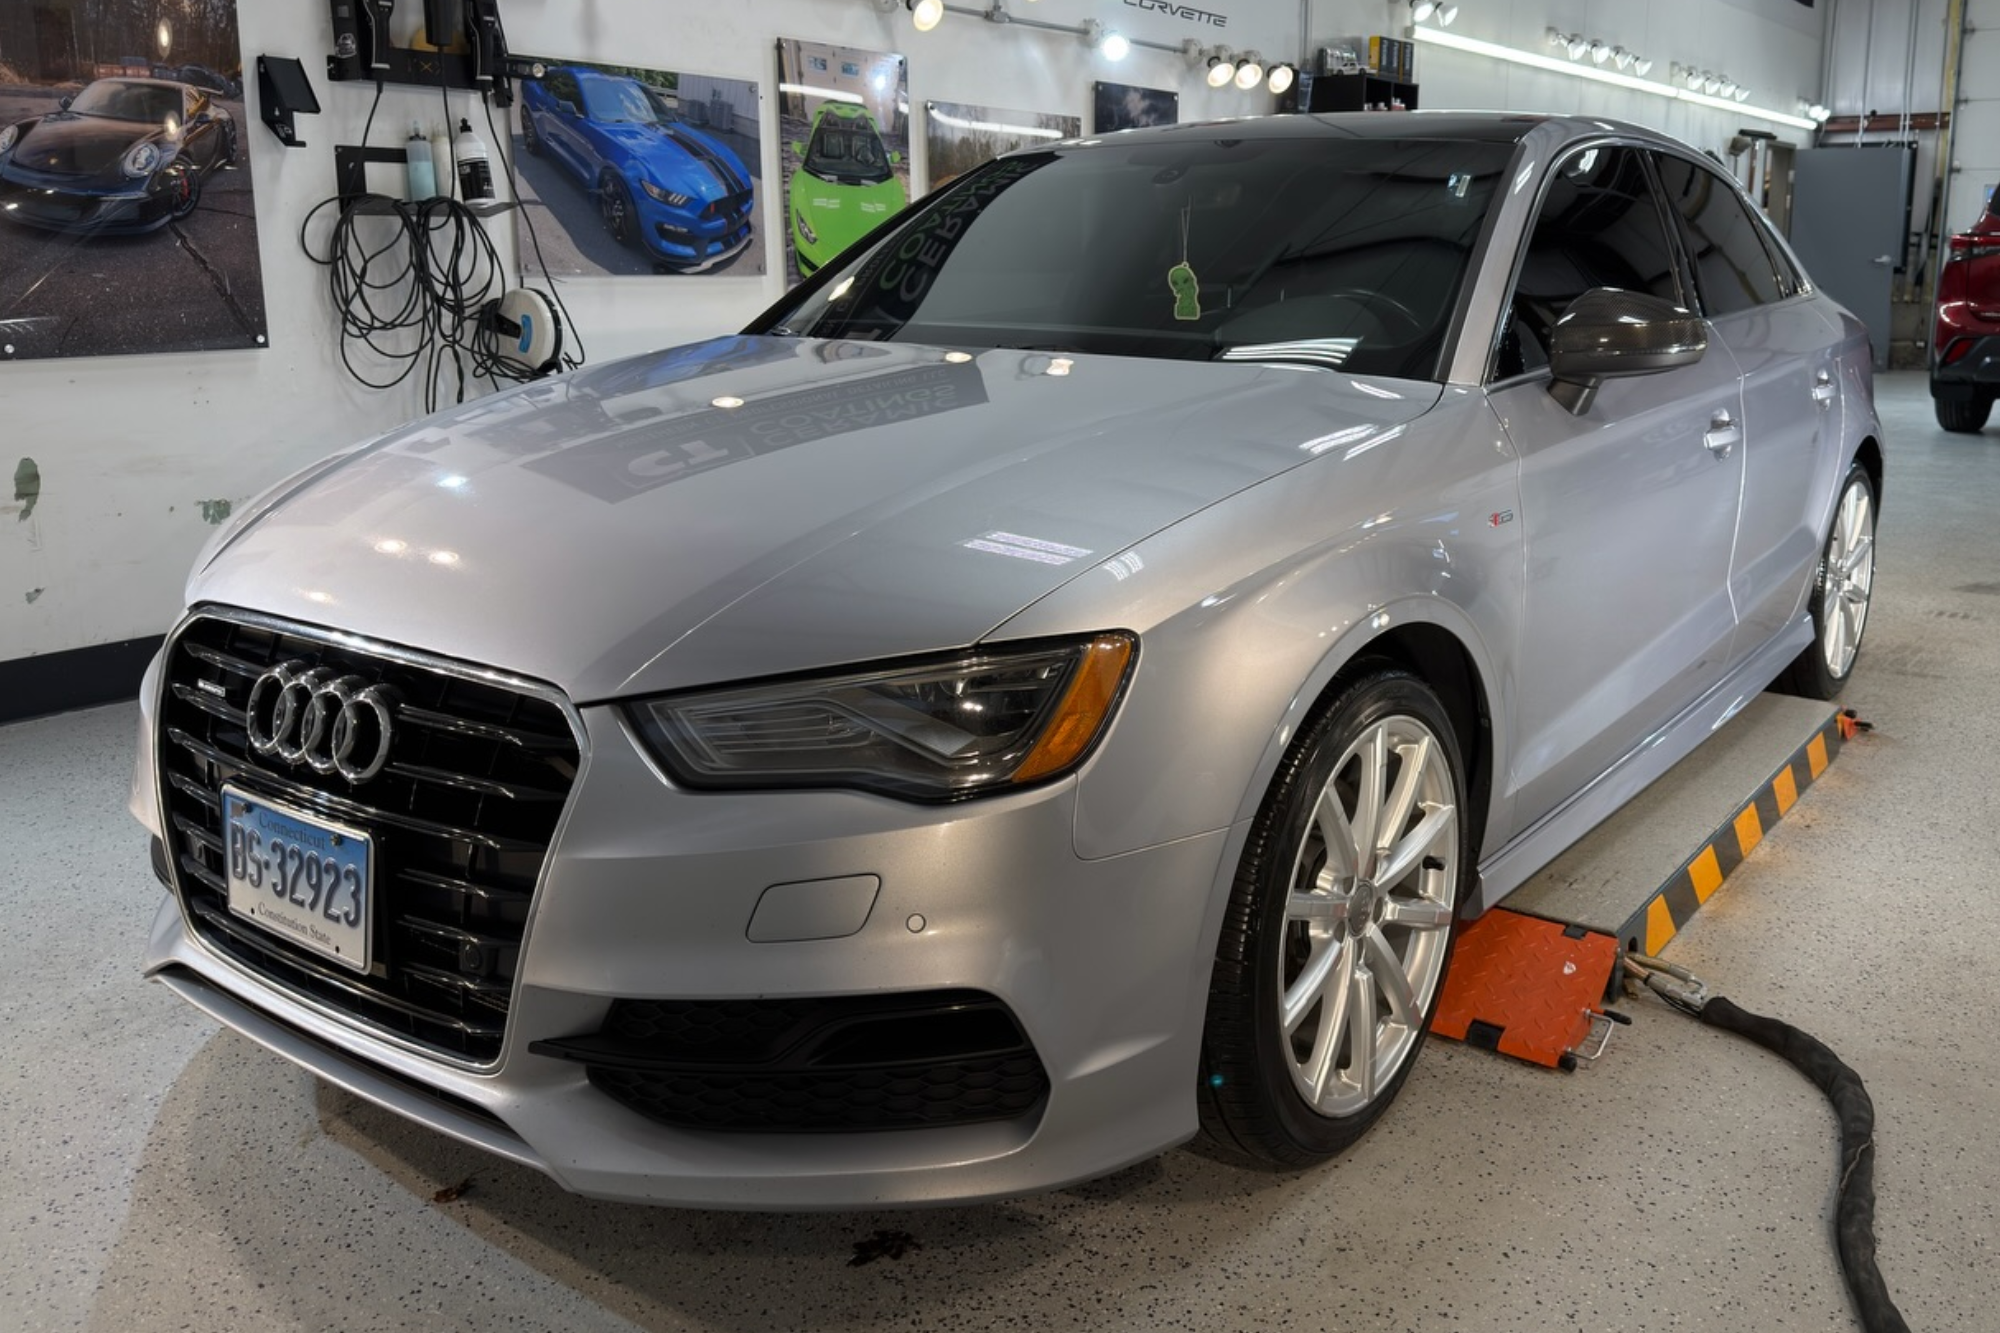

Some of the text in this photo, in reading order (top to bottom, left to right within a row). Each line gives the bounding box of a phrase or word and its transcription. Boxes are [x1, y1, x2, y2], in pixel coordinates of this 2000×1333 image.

[258, 811, 326, 851] Connecticut
[257, 901, 332, 945] Constitution State
